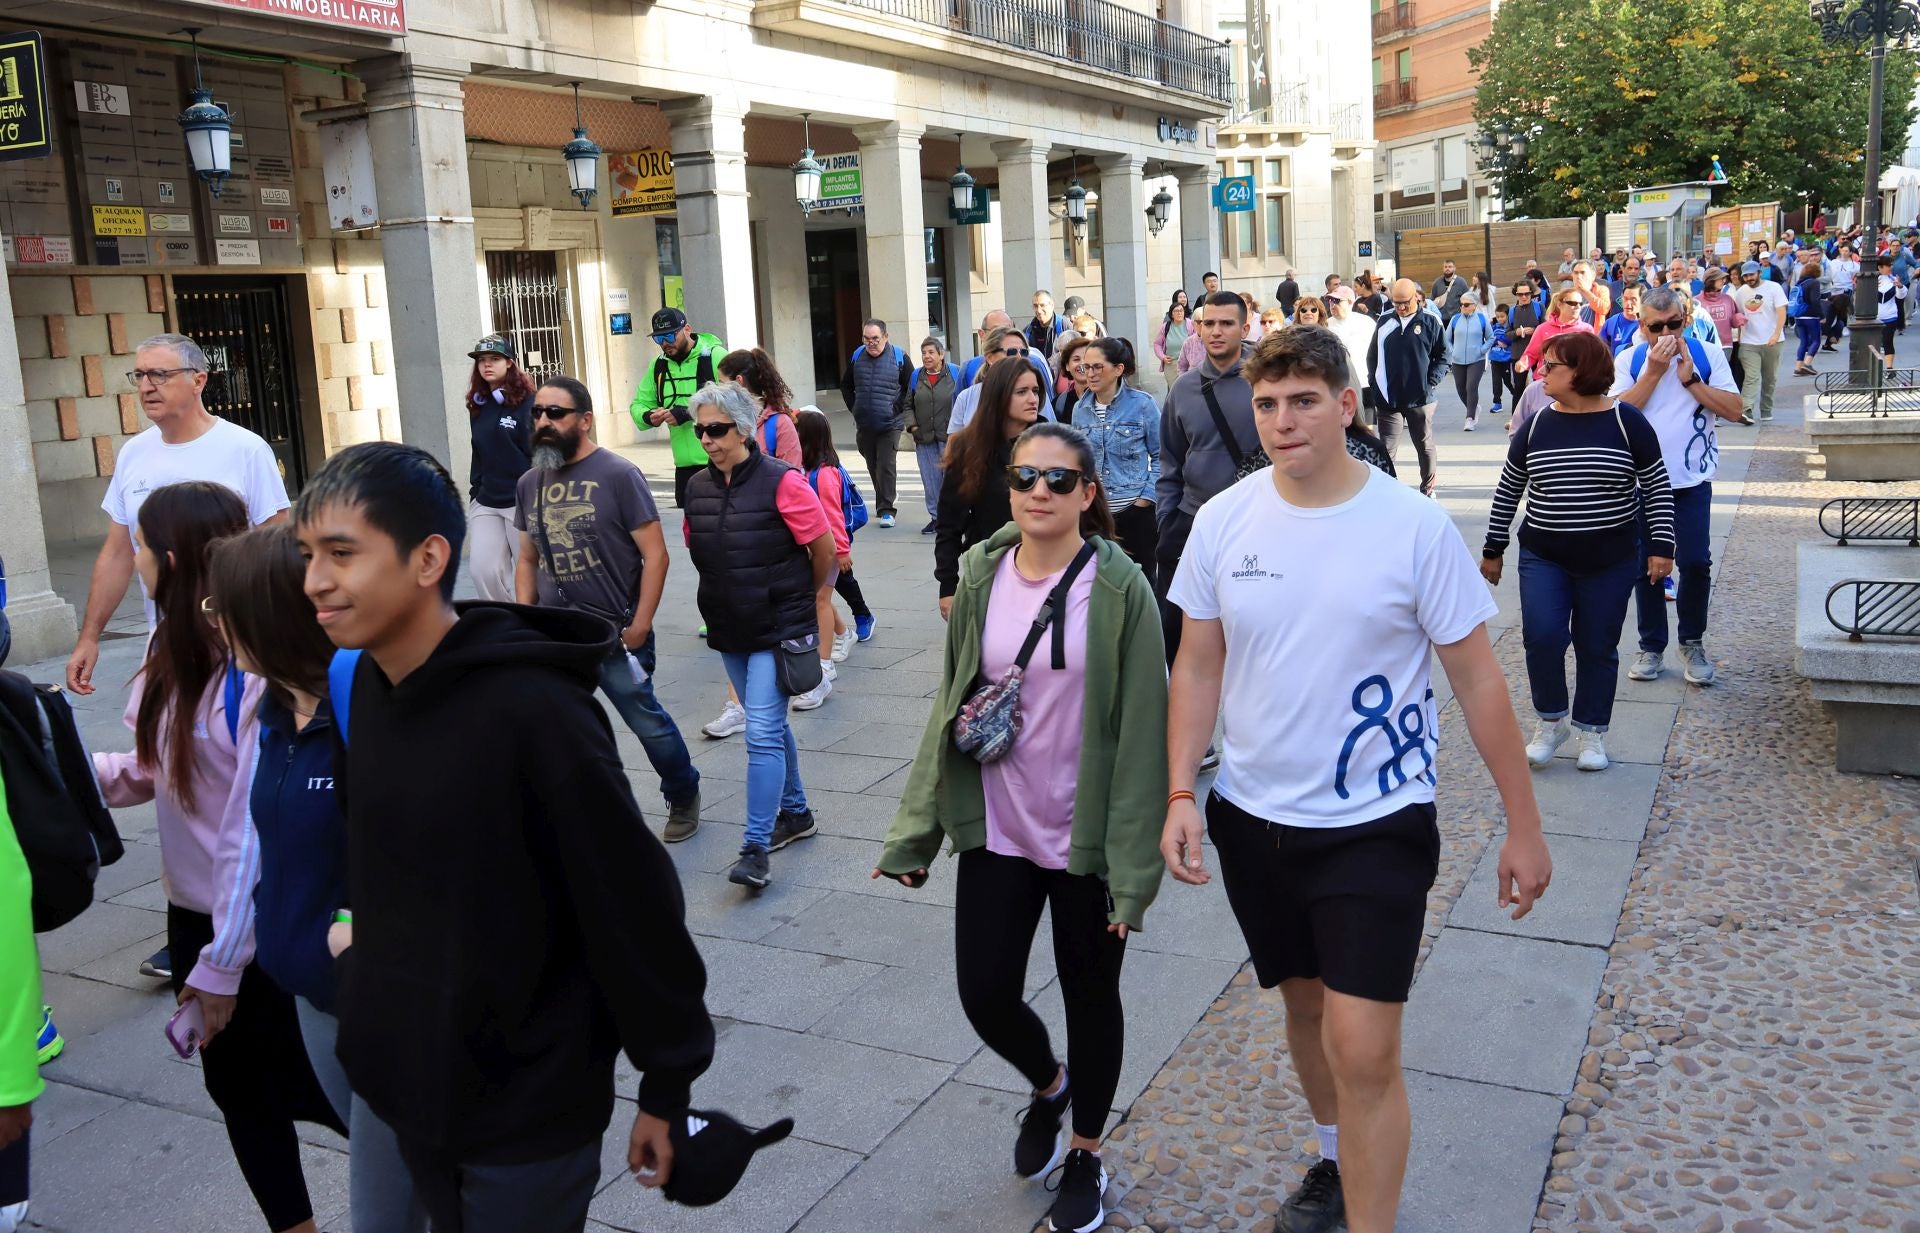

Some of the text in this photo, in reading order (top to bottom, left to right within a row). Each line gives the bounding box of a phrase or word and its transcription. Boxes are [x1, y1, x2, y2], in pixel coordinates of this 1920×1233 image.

[637, 150, 673, 178] ORO
[833, 154, 859, 169] DENTAL
[825, 174, 856, 183] IMPLANTES
[824, 182, 858, 192] ORTODONCIA
[1643, 192, 1666, 201] ONCE
[105, 207, 142, 215] ALQUILAN
[102, 217, 137, 225] OFICINAS
